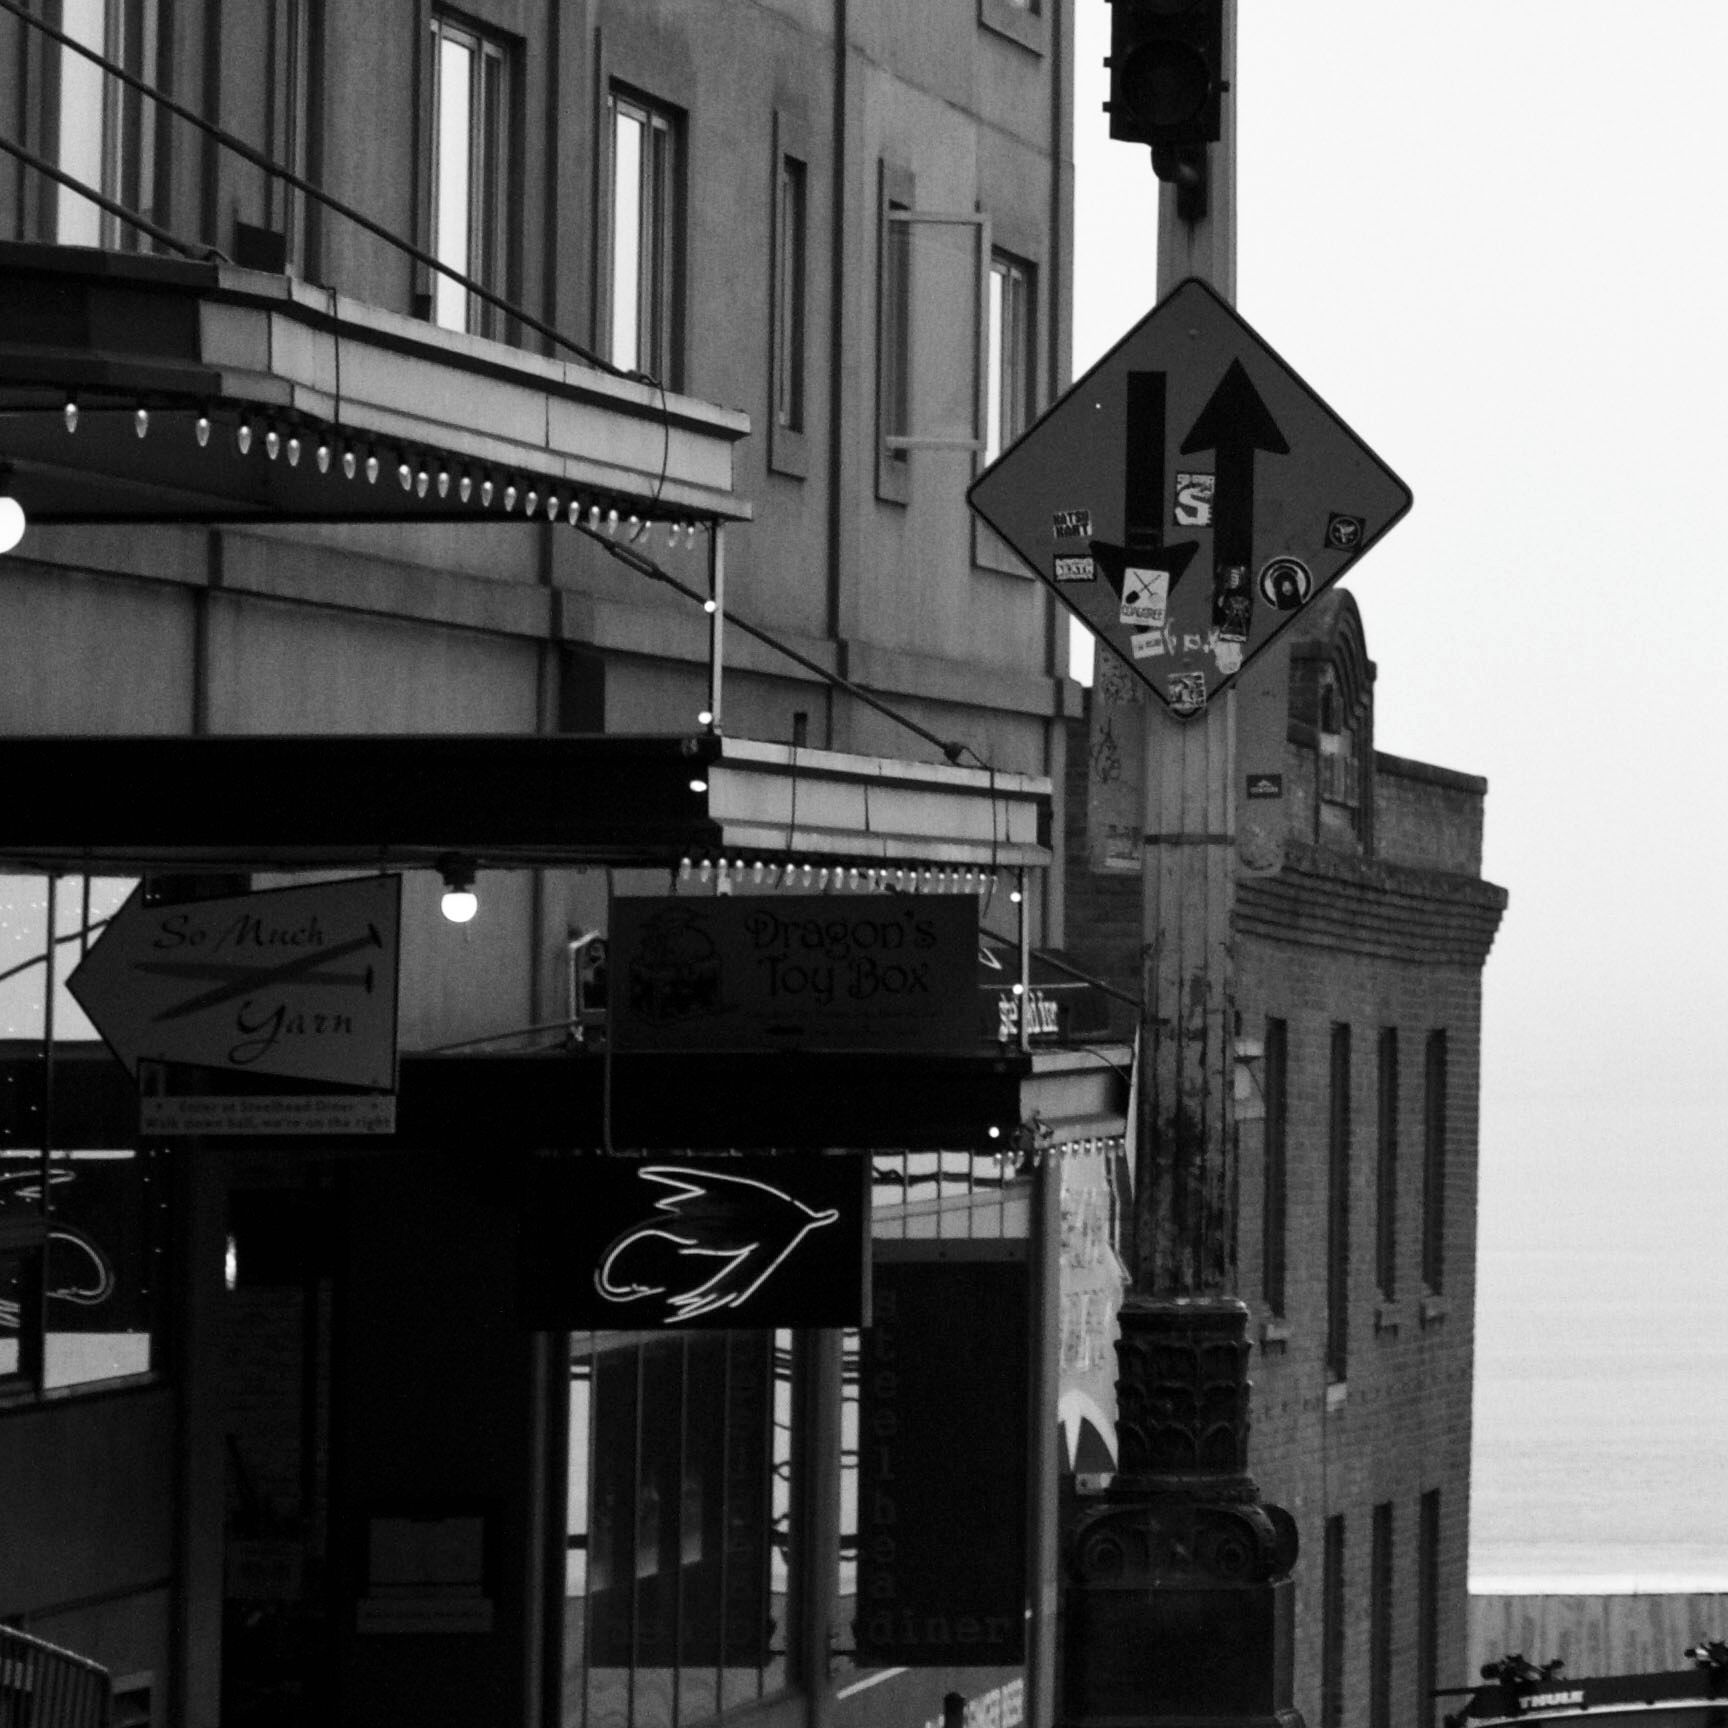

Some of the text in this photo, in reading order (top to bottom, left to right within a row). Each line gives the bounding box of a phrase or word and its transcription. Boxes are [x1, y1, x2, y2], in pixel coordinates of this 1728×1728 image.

[153, 913, 325, 952] So Much
[744, 909, 938, 960] Dragon's
[758, 956, 930, 1006] Toy Box
[227, 999, 354, 1066] Yarn
